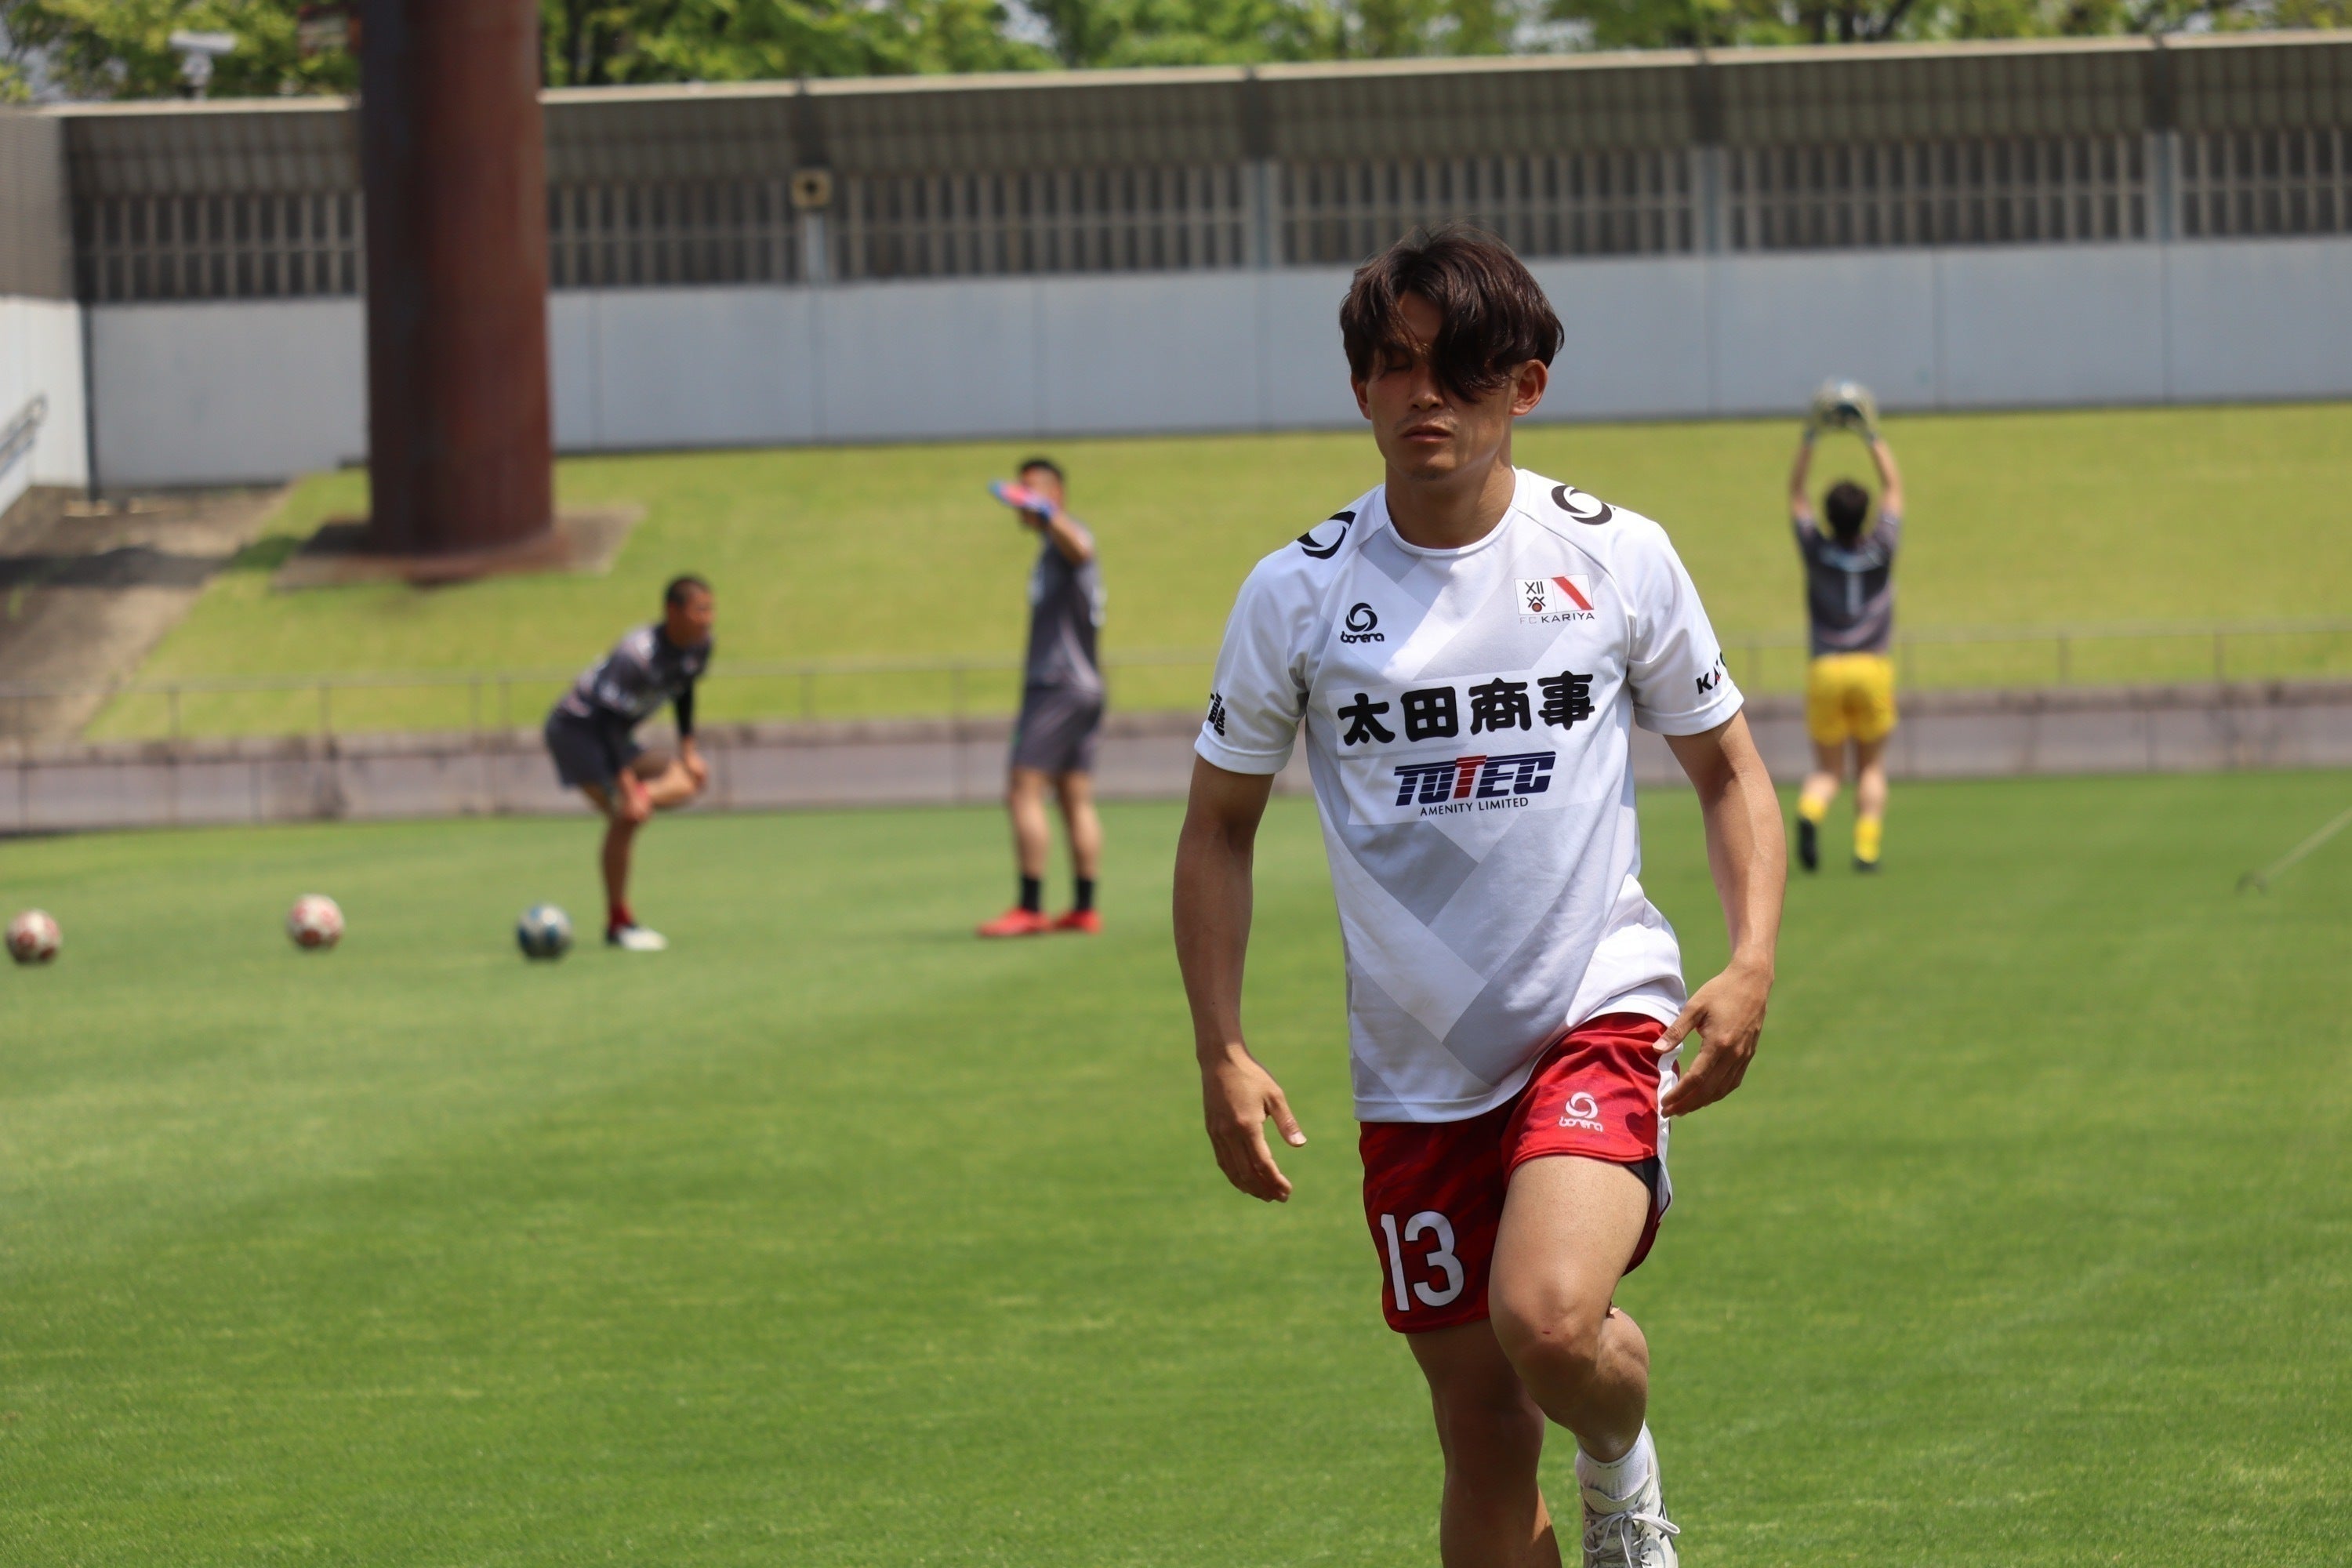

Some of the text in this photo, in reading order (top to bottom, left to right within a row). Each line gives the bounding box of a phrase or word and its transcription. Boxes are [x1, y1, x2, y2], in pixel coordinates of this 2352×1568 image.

[1519, 612, 1595, 625] FC KARIYA
[1338, 670, 1595, 746] 太田商事
[1394, 751, 1556, 807] TOTEC
[1420, 797, 1529, 817] AMENITY LIMITED
[1380, 1210, 1465, 1312] 13
